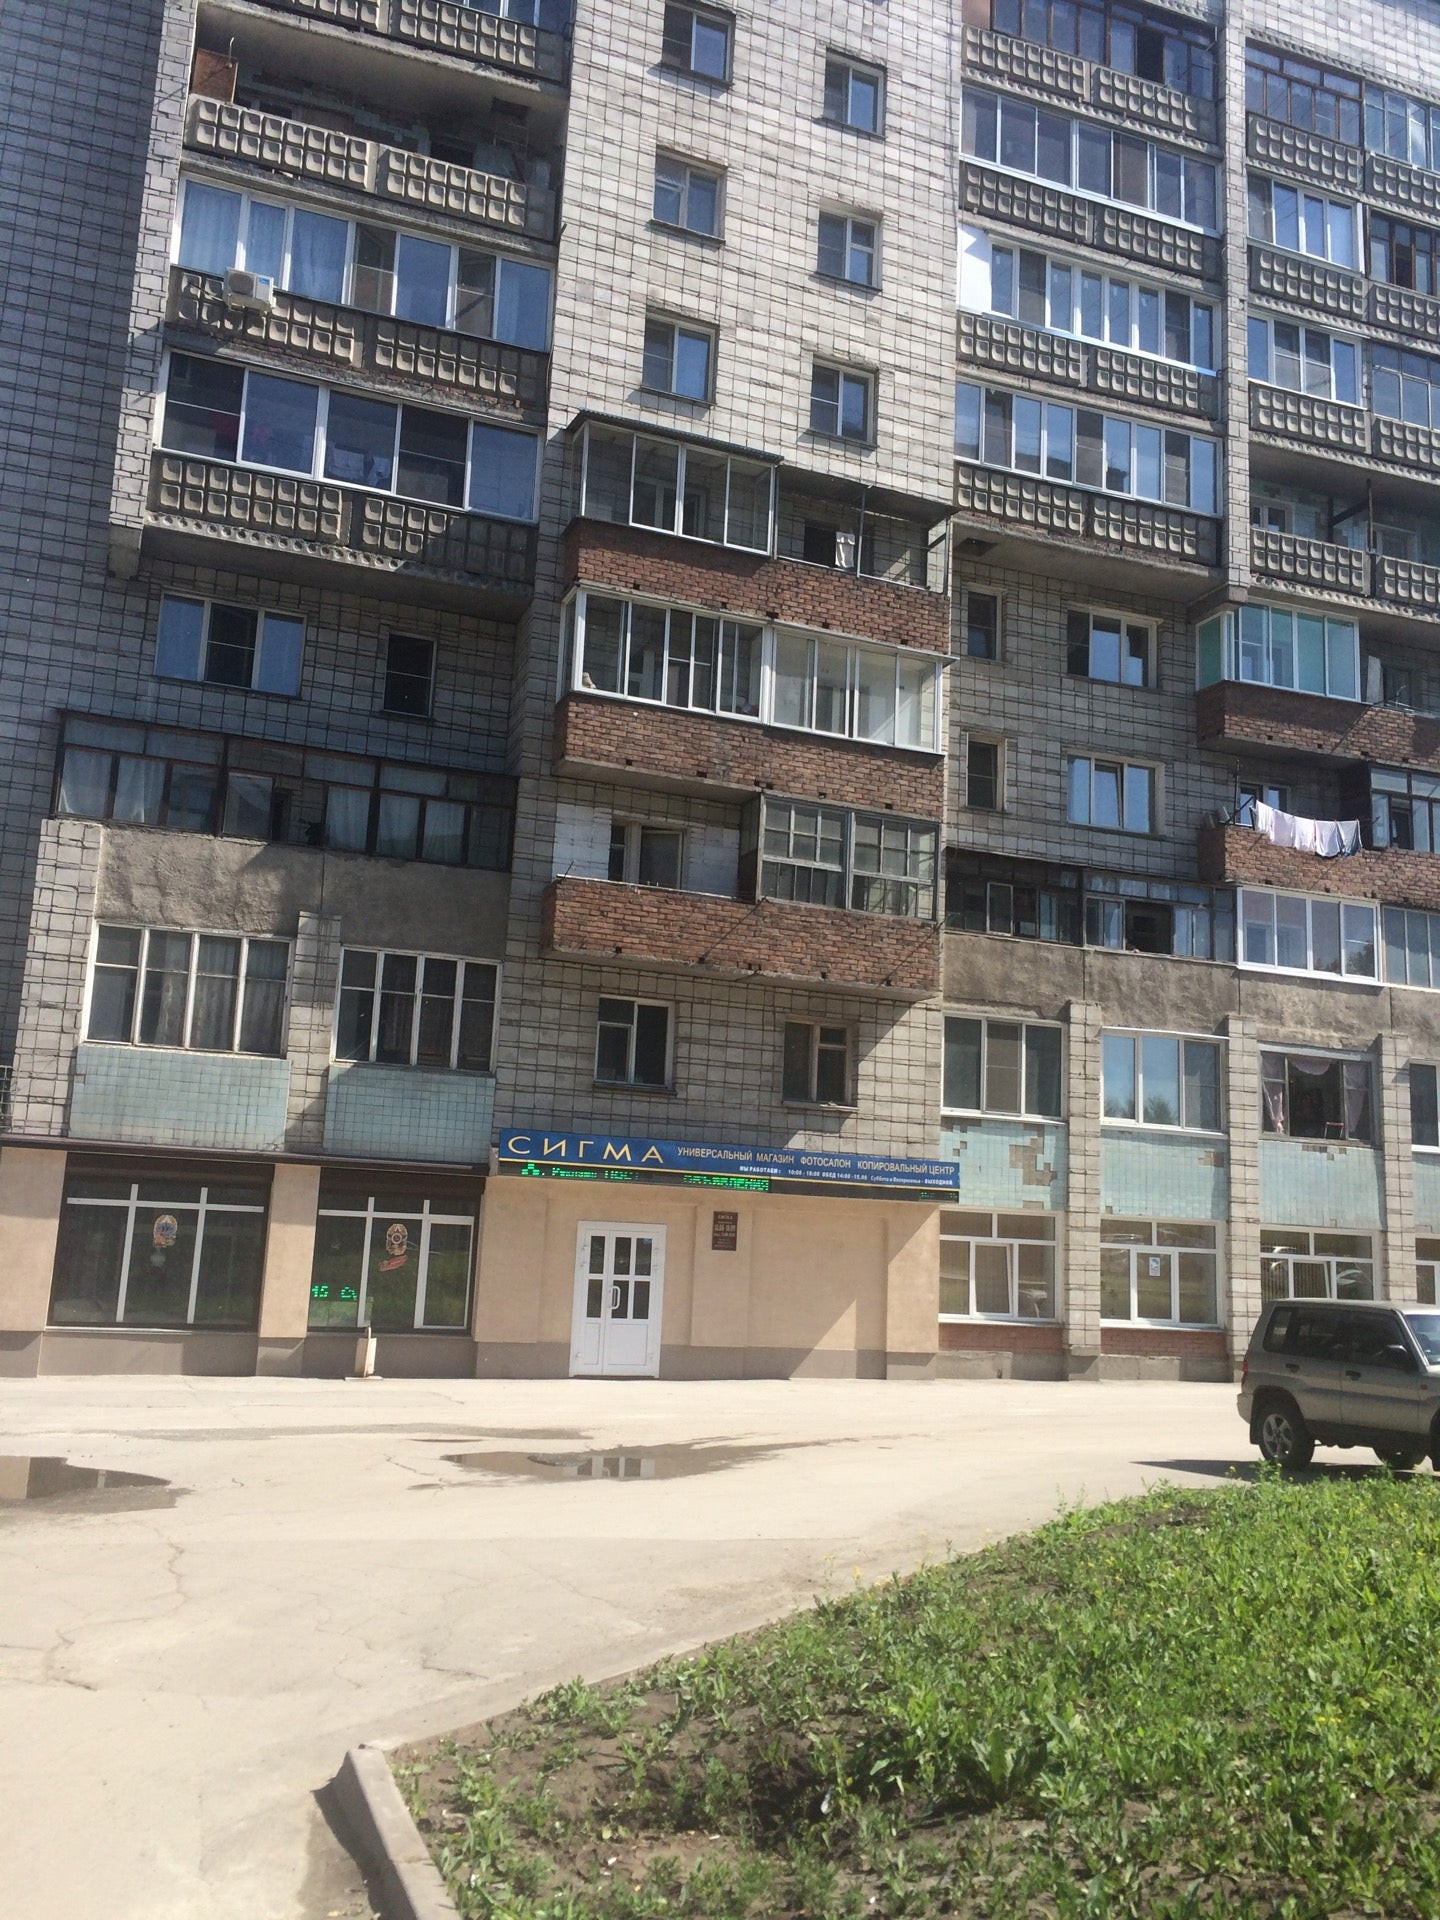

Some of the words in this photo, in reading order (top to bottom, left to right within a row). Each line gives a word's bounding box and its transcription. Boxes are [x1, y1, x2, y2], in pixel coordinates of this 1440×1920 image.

[507, 1135, 664, 1164] СИГМА
[677, 1147, 753, 1160] УНИВЕРСАЛЬНЫЙ
[756, 1152, 795, 1164] МАГАЗИН
[800, 1156, 851, 1168] ФОТОСАЛОН
[857, 1160, 928, 1173] КОПИРОВАЛЬНЫЙ
[928, 1165, 955, 1176] ЦЕНТР
